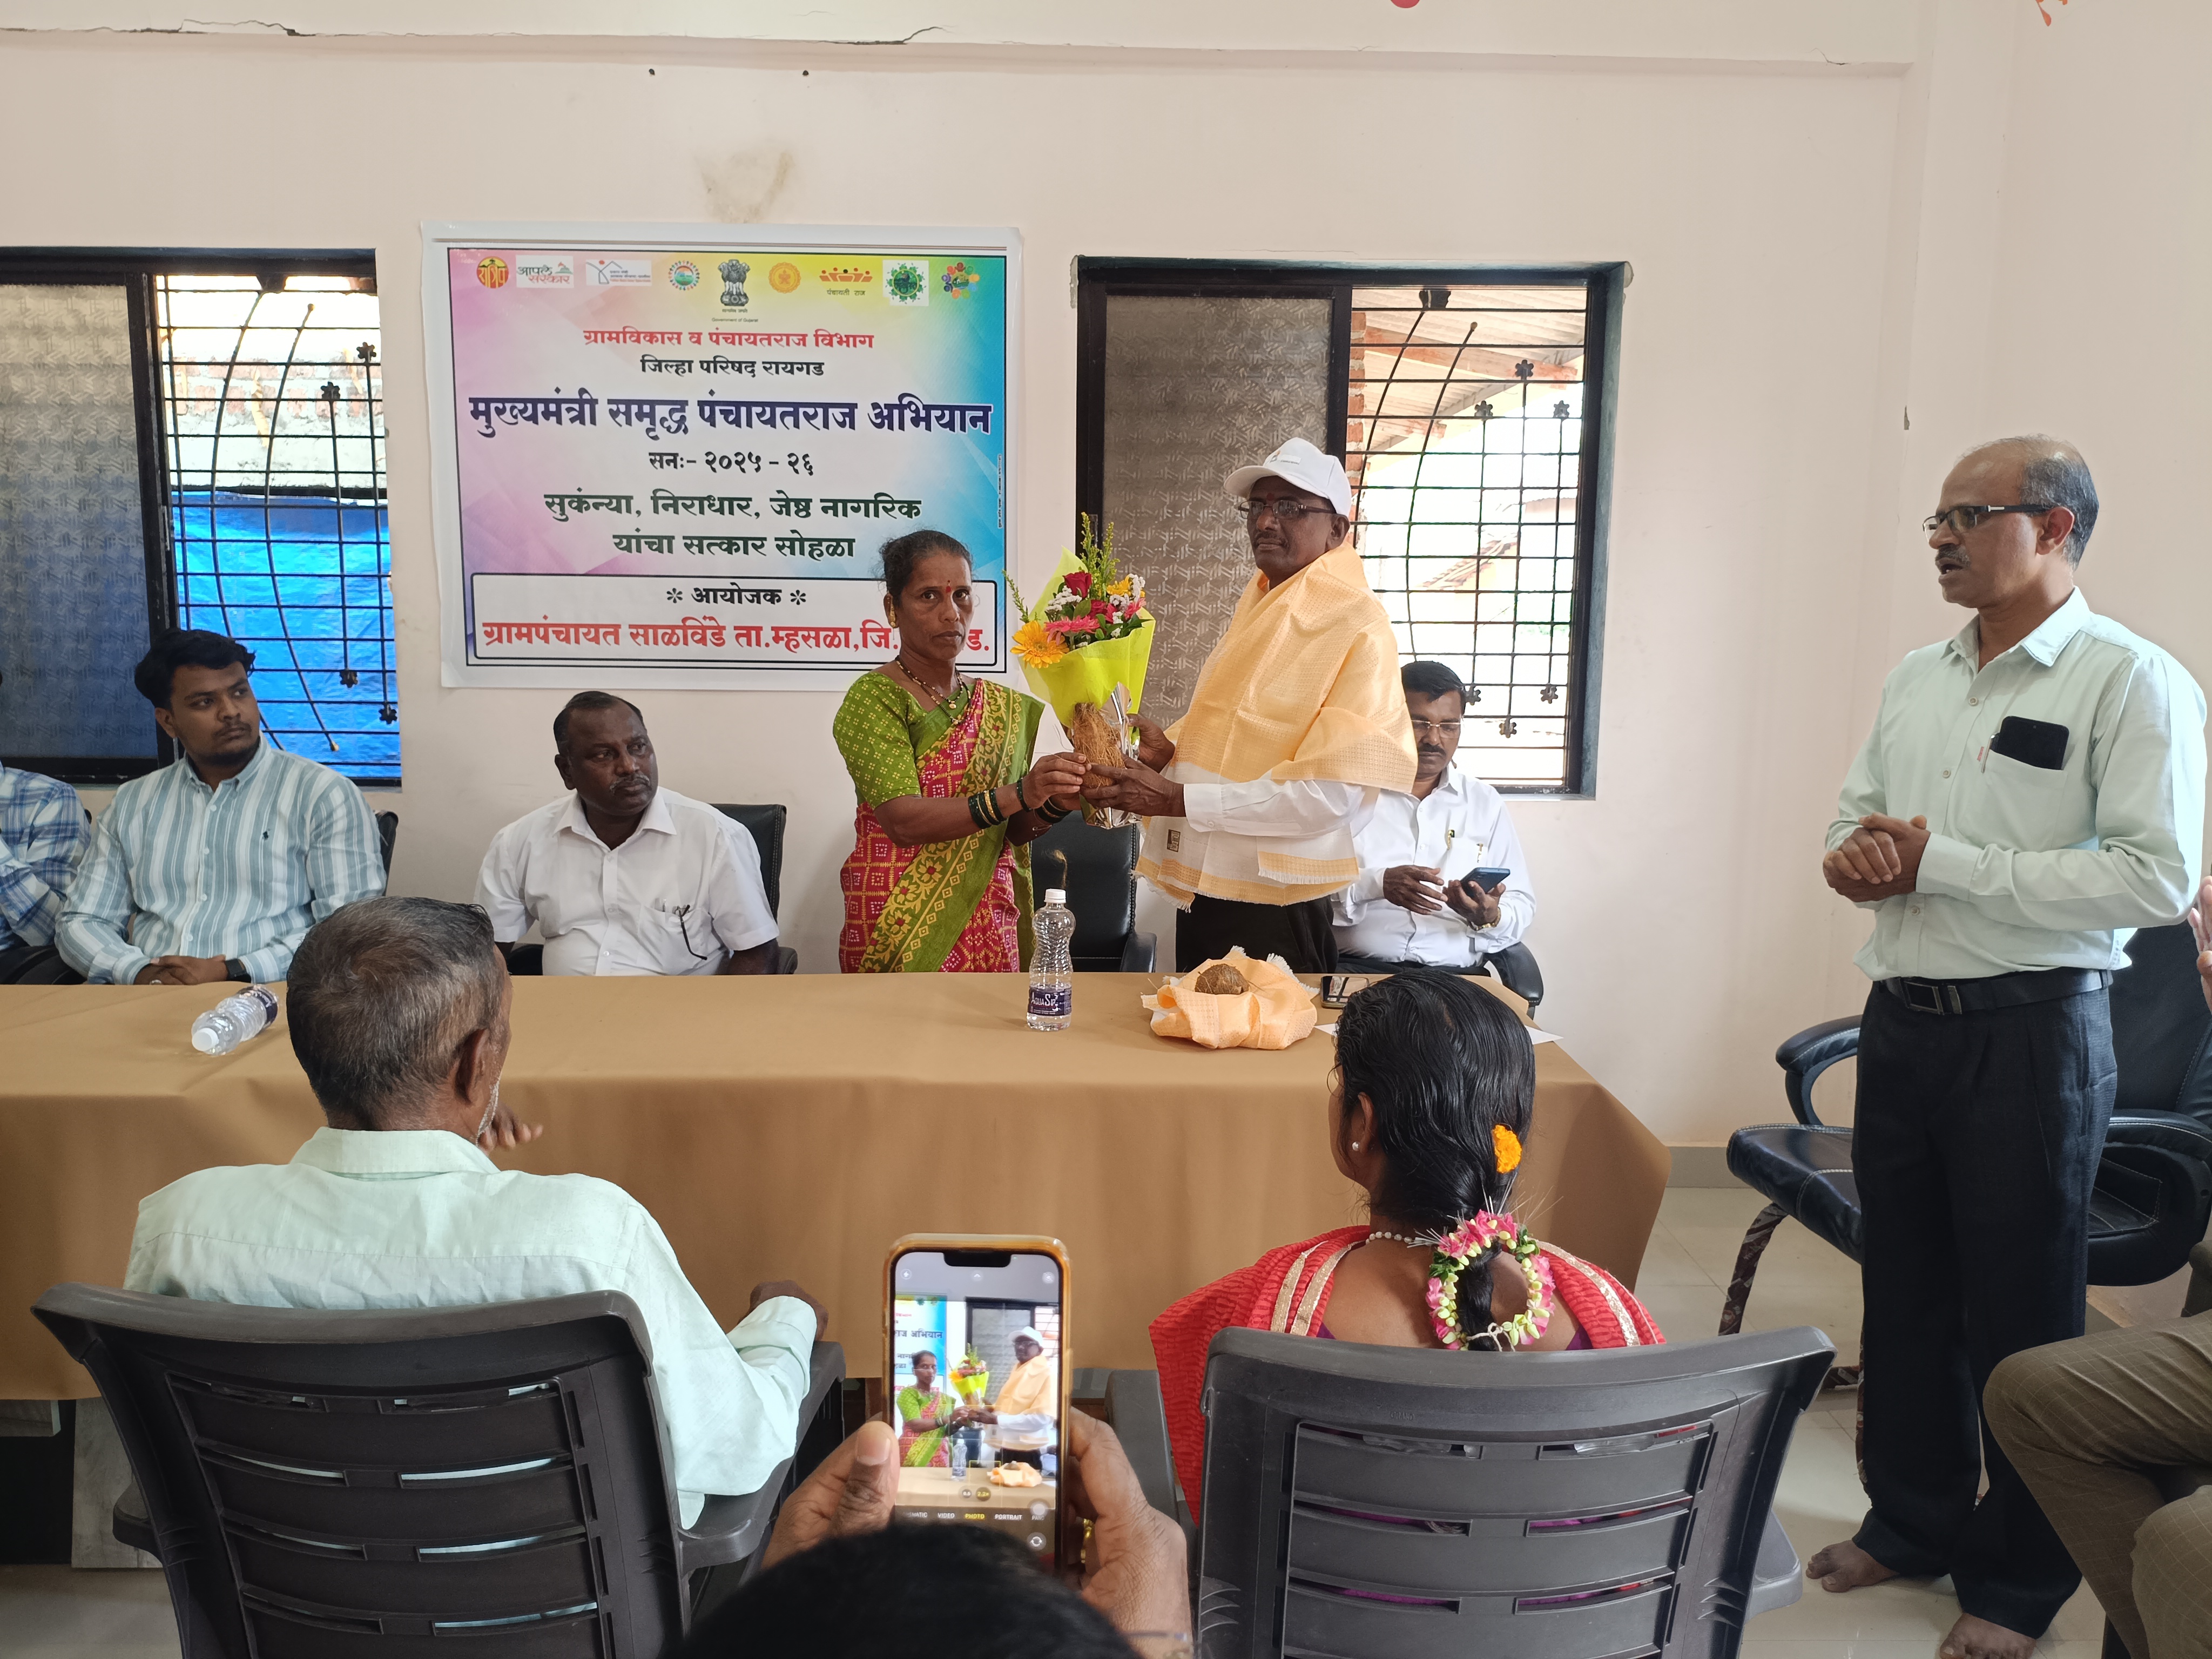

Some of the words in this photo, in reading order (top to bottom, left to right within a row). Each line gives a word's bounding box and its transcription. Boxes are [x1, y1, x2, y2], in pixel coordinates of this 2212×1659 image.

[516, 264, 552, 277] आपले
[826, 288, 850, 296] पंचायती
[583, 326, 683, 346] ग्रामविकास
[689, 332, 703, 345] व
[709, 327, 808, 347] पंचायतराज
[814, 328, 874, 348] विभाग
[640, 354, 694, 377] जिल्हा
[699, 355, 757, 377] परिषद
[762, 361, 825, 376] रायगड
[468, 386, 598, 438] मुख्यमंत्री
[607, 398, 689, 441] समृद्ध
[697, 389, 858, 431] पंचायतराज
[867, 392, 993, 435] अभियान
[705, 451, 762, 473] २०२५
[787, 452, 814, 476] २६
[543, 487, 642, 522] सुकंन्या,
[650, 488, 760, 520] निराधार,
[770, 490, 812, 518] जेष्ठ
[820, 492, 921, 519] नागरिक
[612, 527, 675, 555] यांचा
[682, 535, 767, 557] सत्कार
[774, 529, 856, 561] सोहळा
[690, 582, 783, 605] आयोजक
[482, 614, 622, 646] ग्रामपंचायत
[629, 615, 726, 648] साळविंडे
[911, 1328, 943, 1339] अभियान
